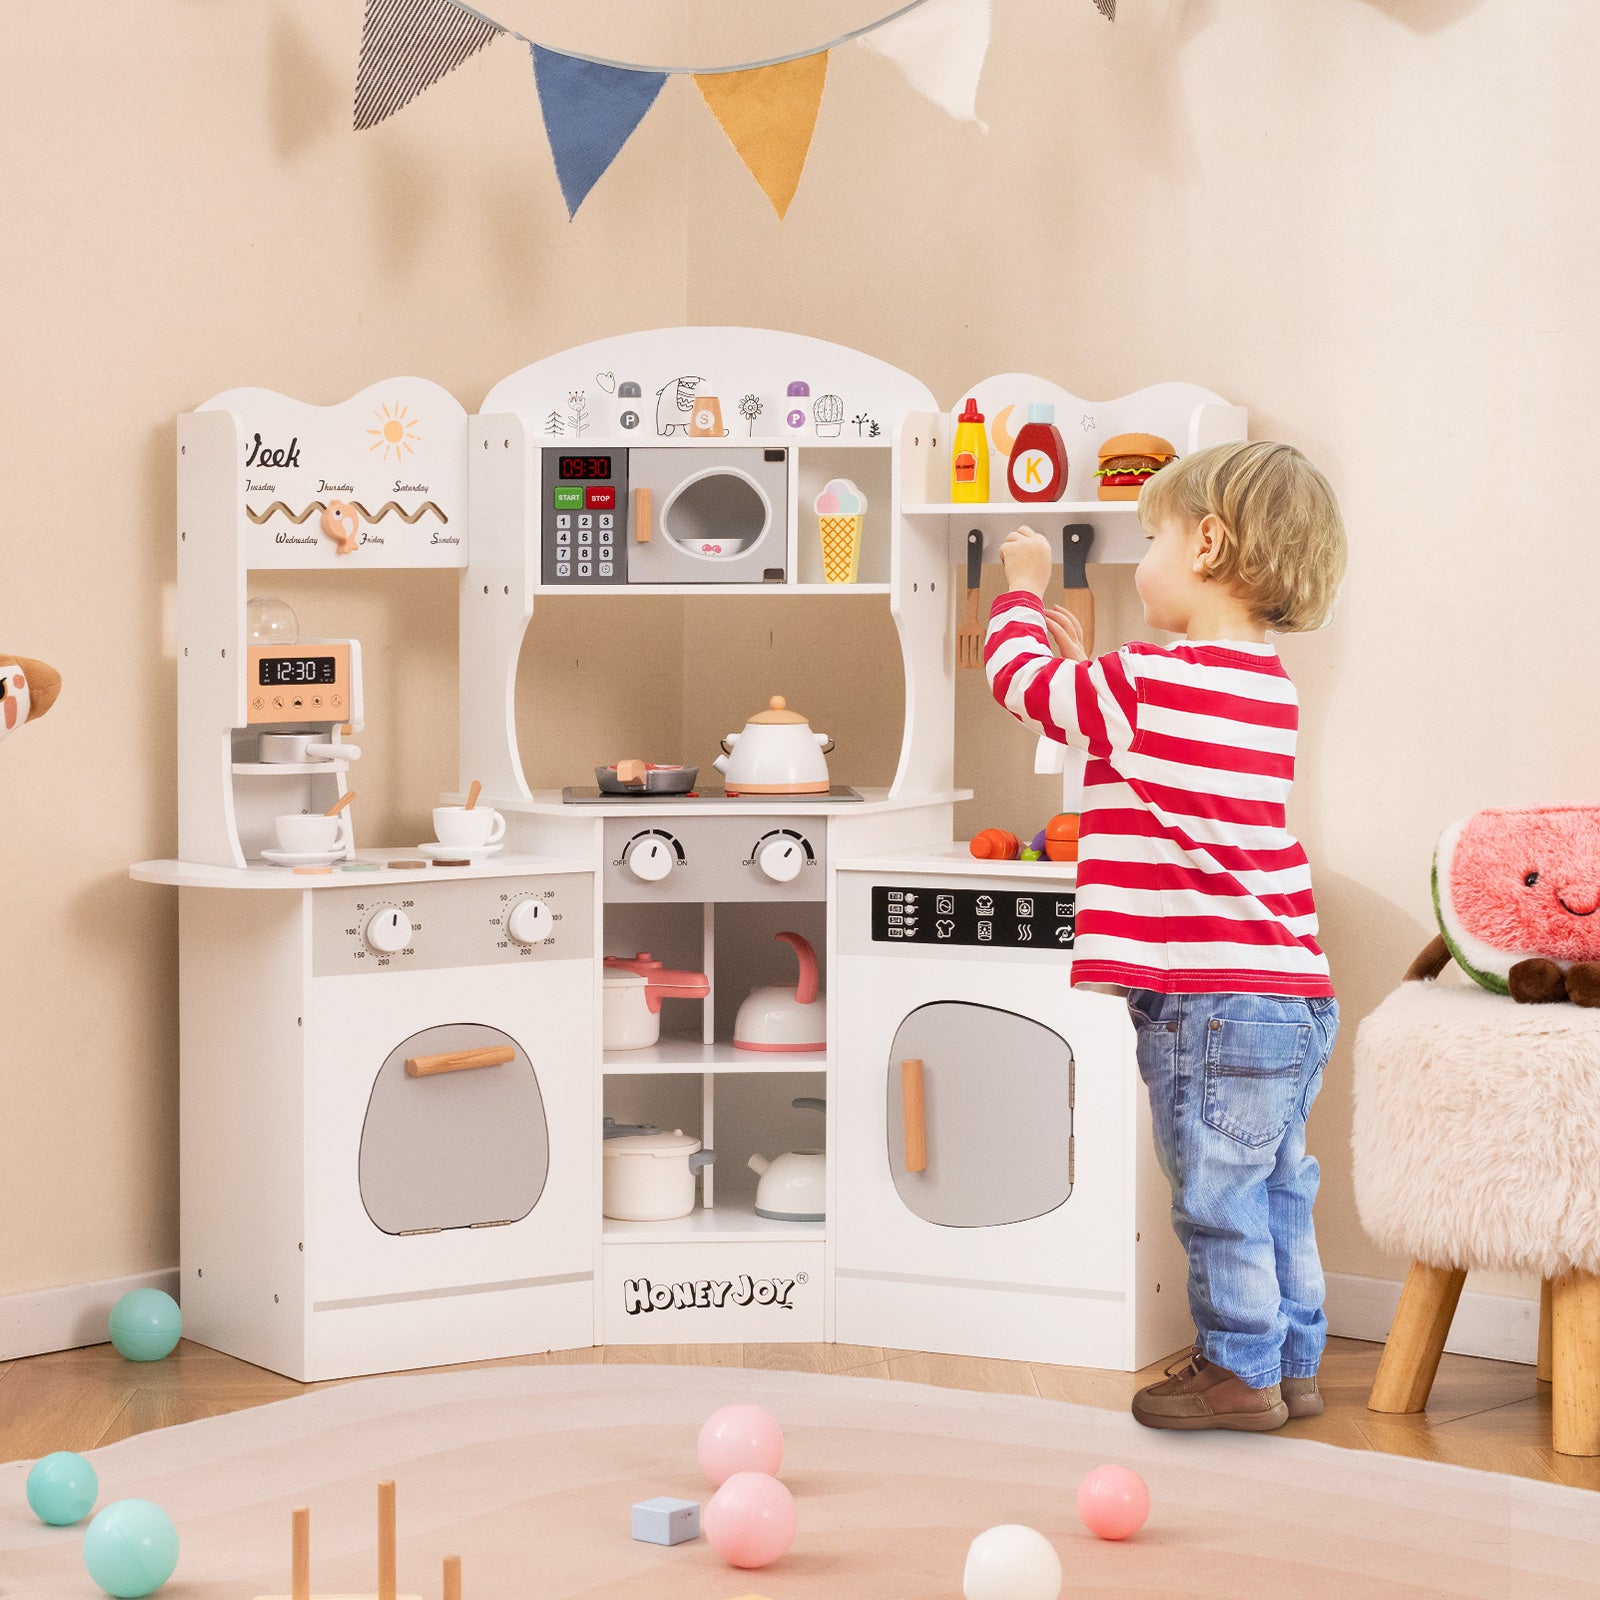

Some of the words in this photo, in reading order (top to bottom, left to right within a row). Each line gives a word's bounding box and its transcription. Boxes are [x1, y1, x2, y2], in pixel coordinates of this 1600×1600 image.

[625, 414, 635, 425] P
[699, 414, 709, 425] S
[791, 413, 800, 424] P
[563, 459, 607, 477] 09:30
[1025, 457, 1044, 485] K
[316, 480, 354, 493] Thursday
[392, 480, 429, 493] Saturday
[560, 517, 567, 526] 1
[581, 517, 589, 526] 2
[602, 517, 610, 526] 3
[275, 533, 318, 545] Wednesday
[359, 533, 385, 545] Friday
[430, 533, 460, 545] Sunday
[560, 533, 567, 542] 4
[581, 533, 589, 542] 5
[602, 533, 610, 542] 6
[560, 549, 567, 558] 7
[581, 549, 589, 558] 8
[602, 549, 610, 558] 9
[581, 565, 589, 574] 0
[277, 661, 316, 681] 12:30
[356, 903, 365, 911] 50
[543, 937, 555, 945] 250
[378, 958, 390, 966] 200
